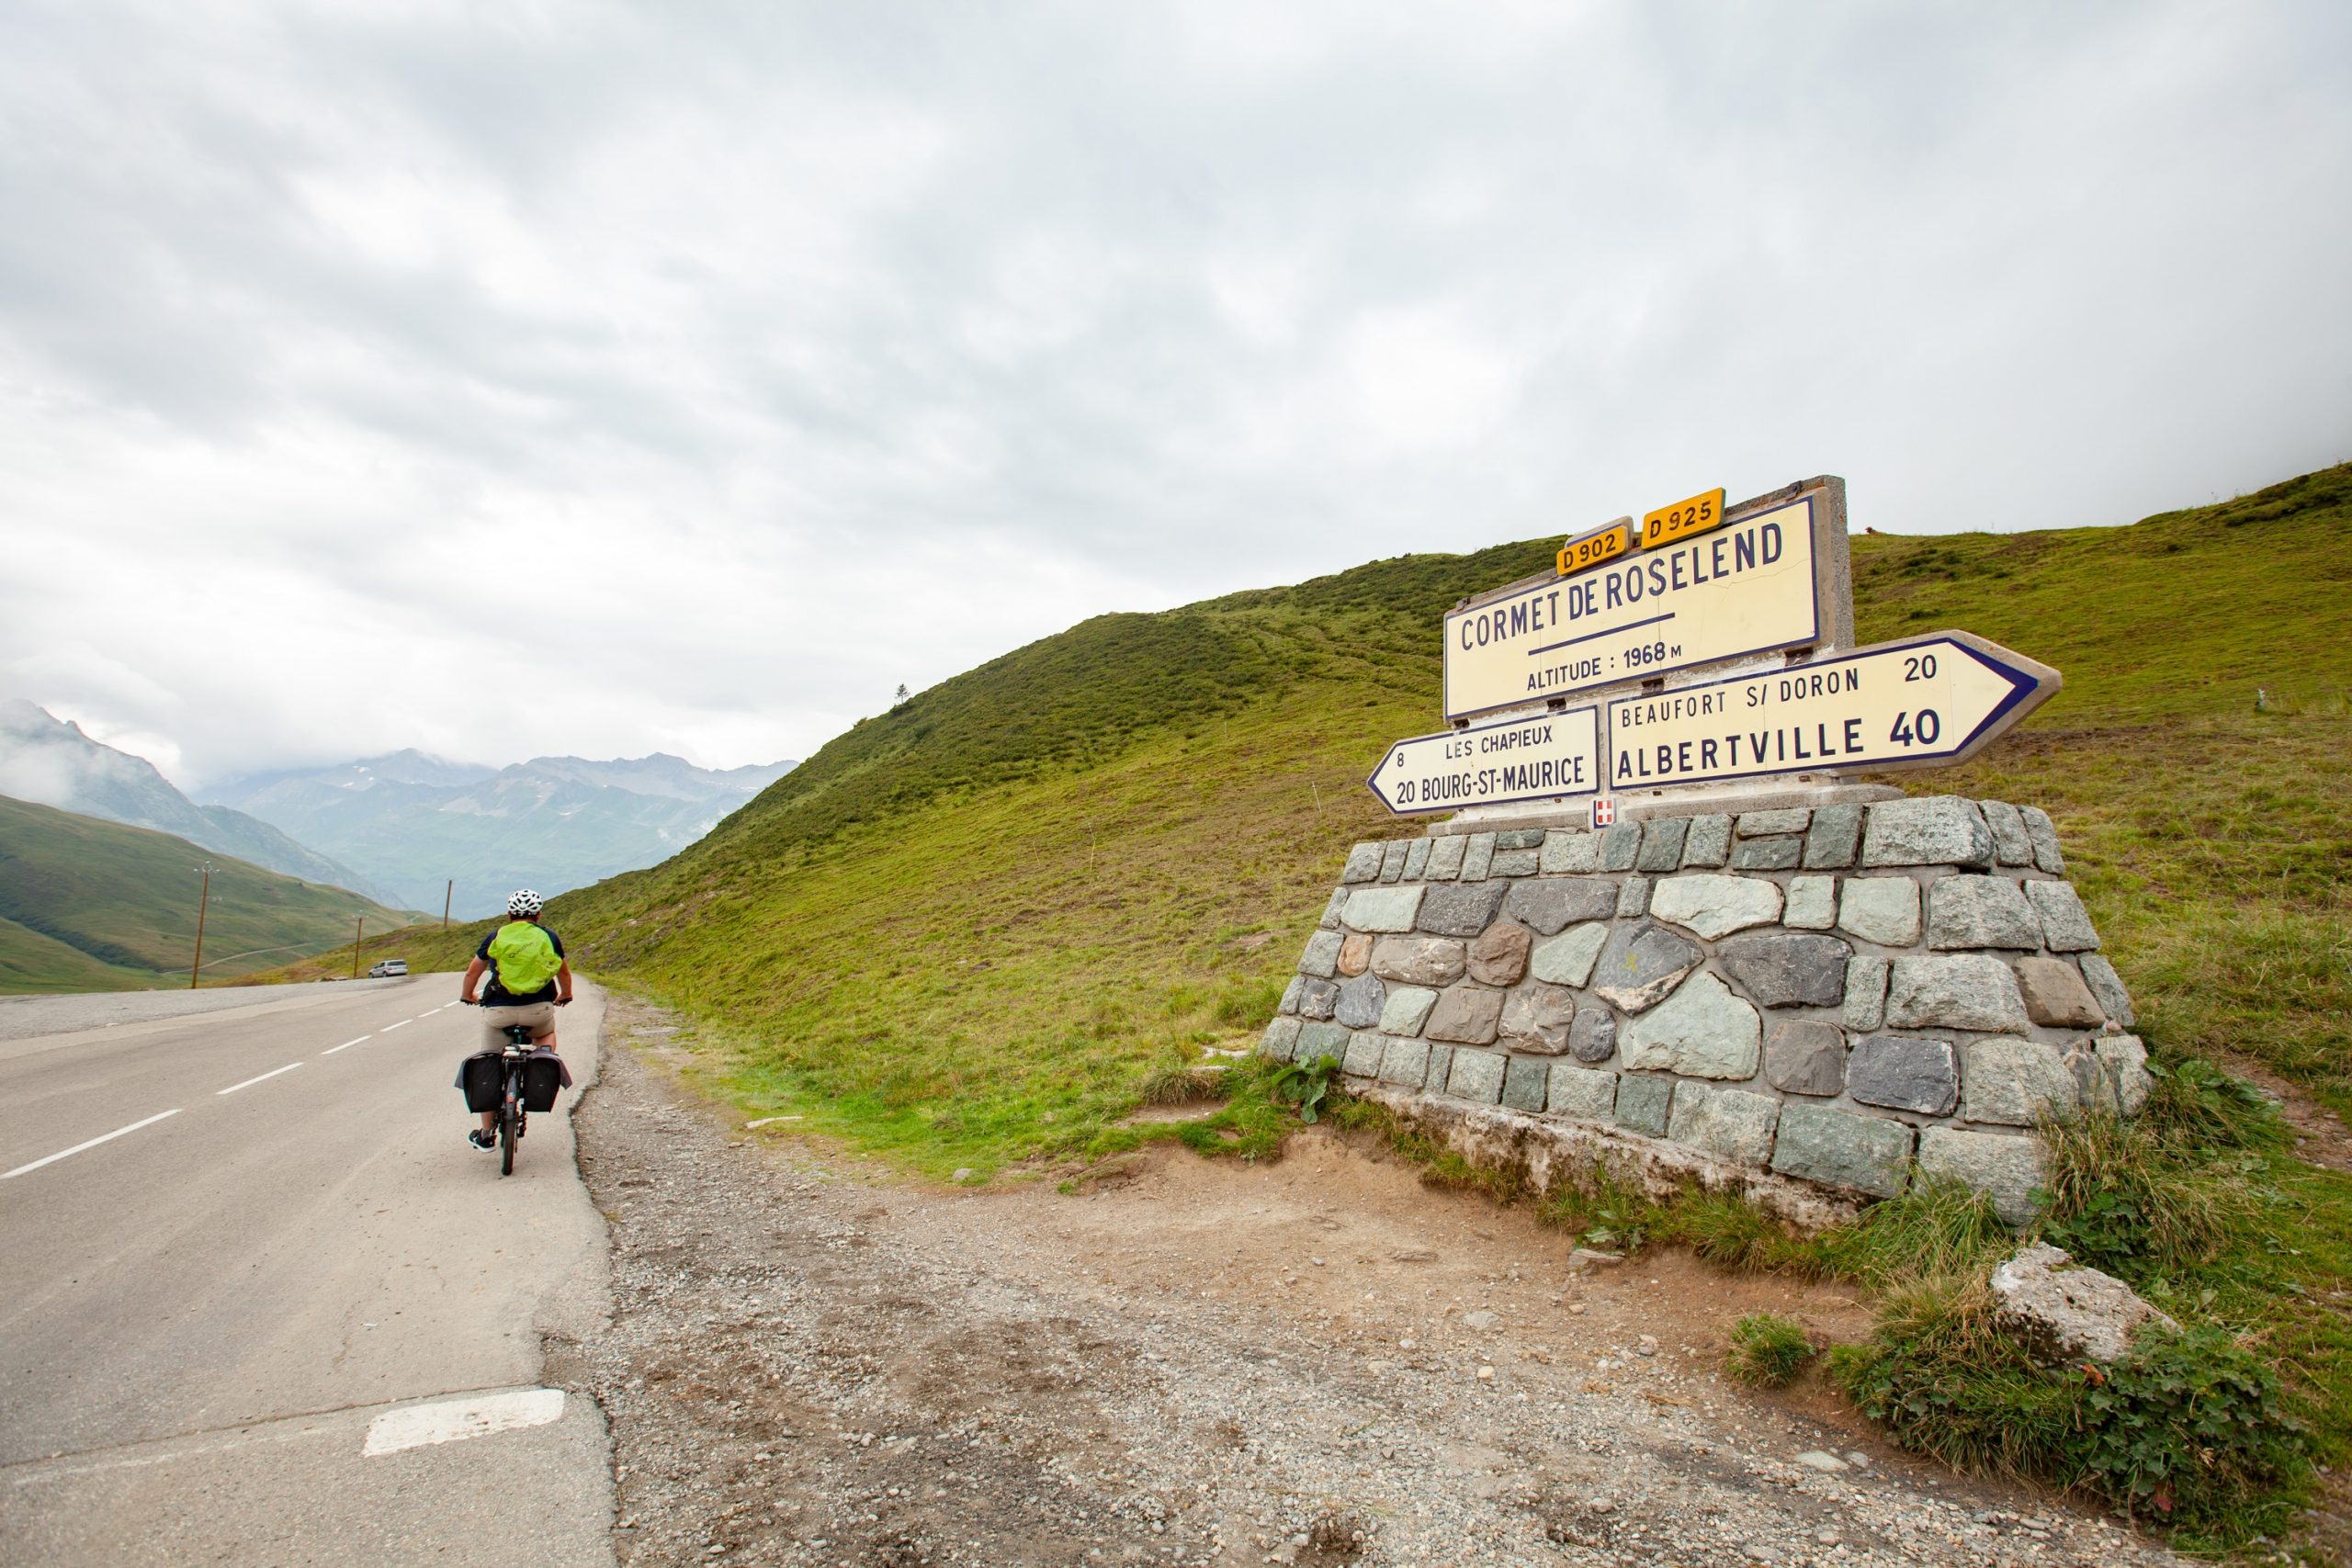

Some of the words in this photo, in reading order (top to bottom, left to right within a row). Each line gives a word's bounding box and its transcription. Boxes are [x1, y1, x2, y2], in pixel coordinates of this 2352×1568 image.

[1650, 520, 1661, 539] D
[1668, 501, 1712, 531] 925
[1564, 551, 1574, 569] D
[1580, 534, 1616, 562] 902
[1462, 591, 1560, 650] CORMET
[1569, 579, 1599, 620] DE
[1606, 523, 1781, 610] ROSELEND
[1528, 657, 1601, 691] ALTITUDE
[1623, 642, 1666, 669] 1968
[1670, 645, 1681, 658] M
[1623, 692, 1725, 728] BEAUFORT
[1747, 684, 1768, 707] S/
[1781, 668, 1859, 702] DORON
[1904, 654, 1937, 682] 20
[1396, 752, 1405, 768] 8
[1446, 740, 1473, 760] LES
[1481, 725, 1553, 753] CHAPIEUX
[1617, 718, 1864, 779] ALBERTVILLE
[1890, 709, 1940, 747] 40
[1396, 781, 1415, 804] 20
[1422, 756, 1585, 801] BOURG-ST-MAURICE
